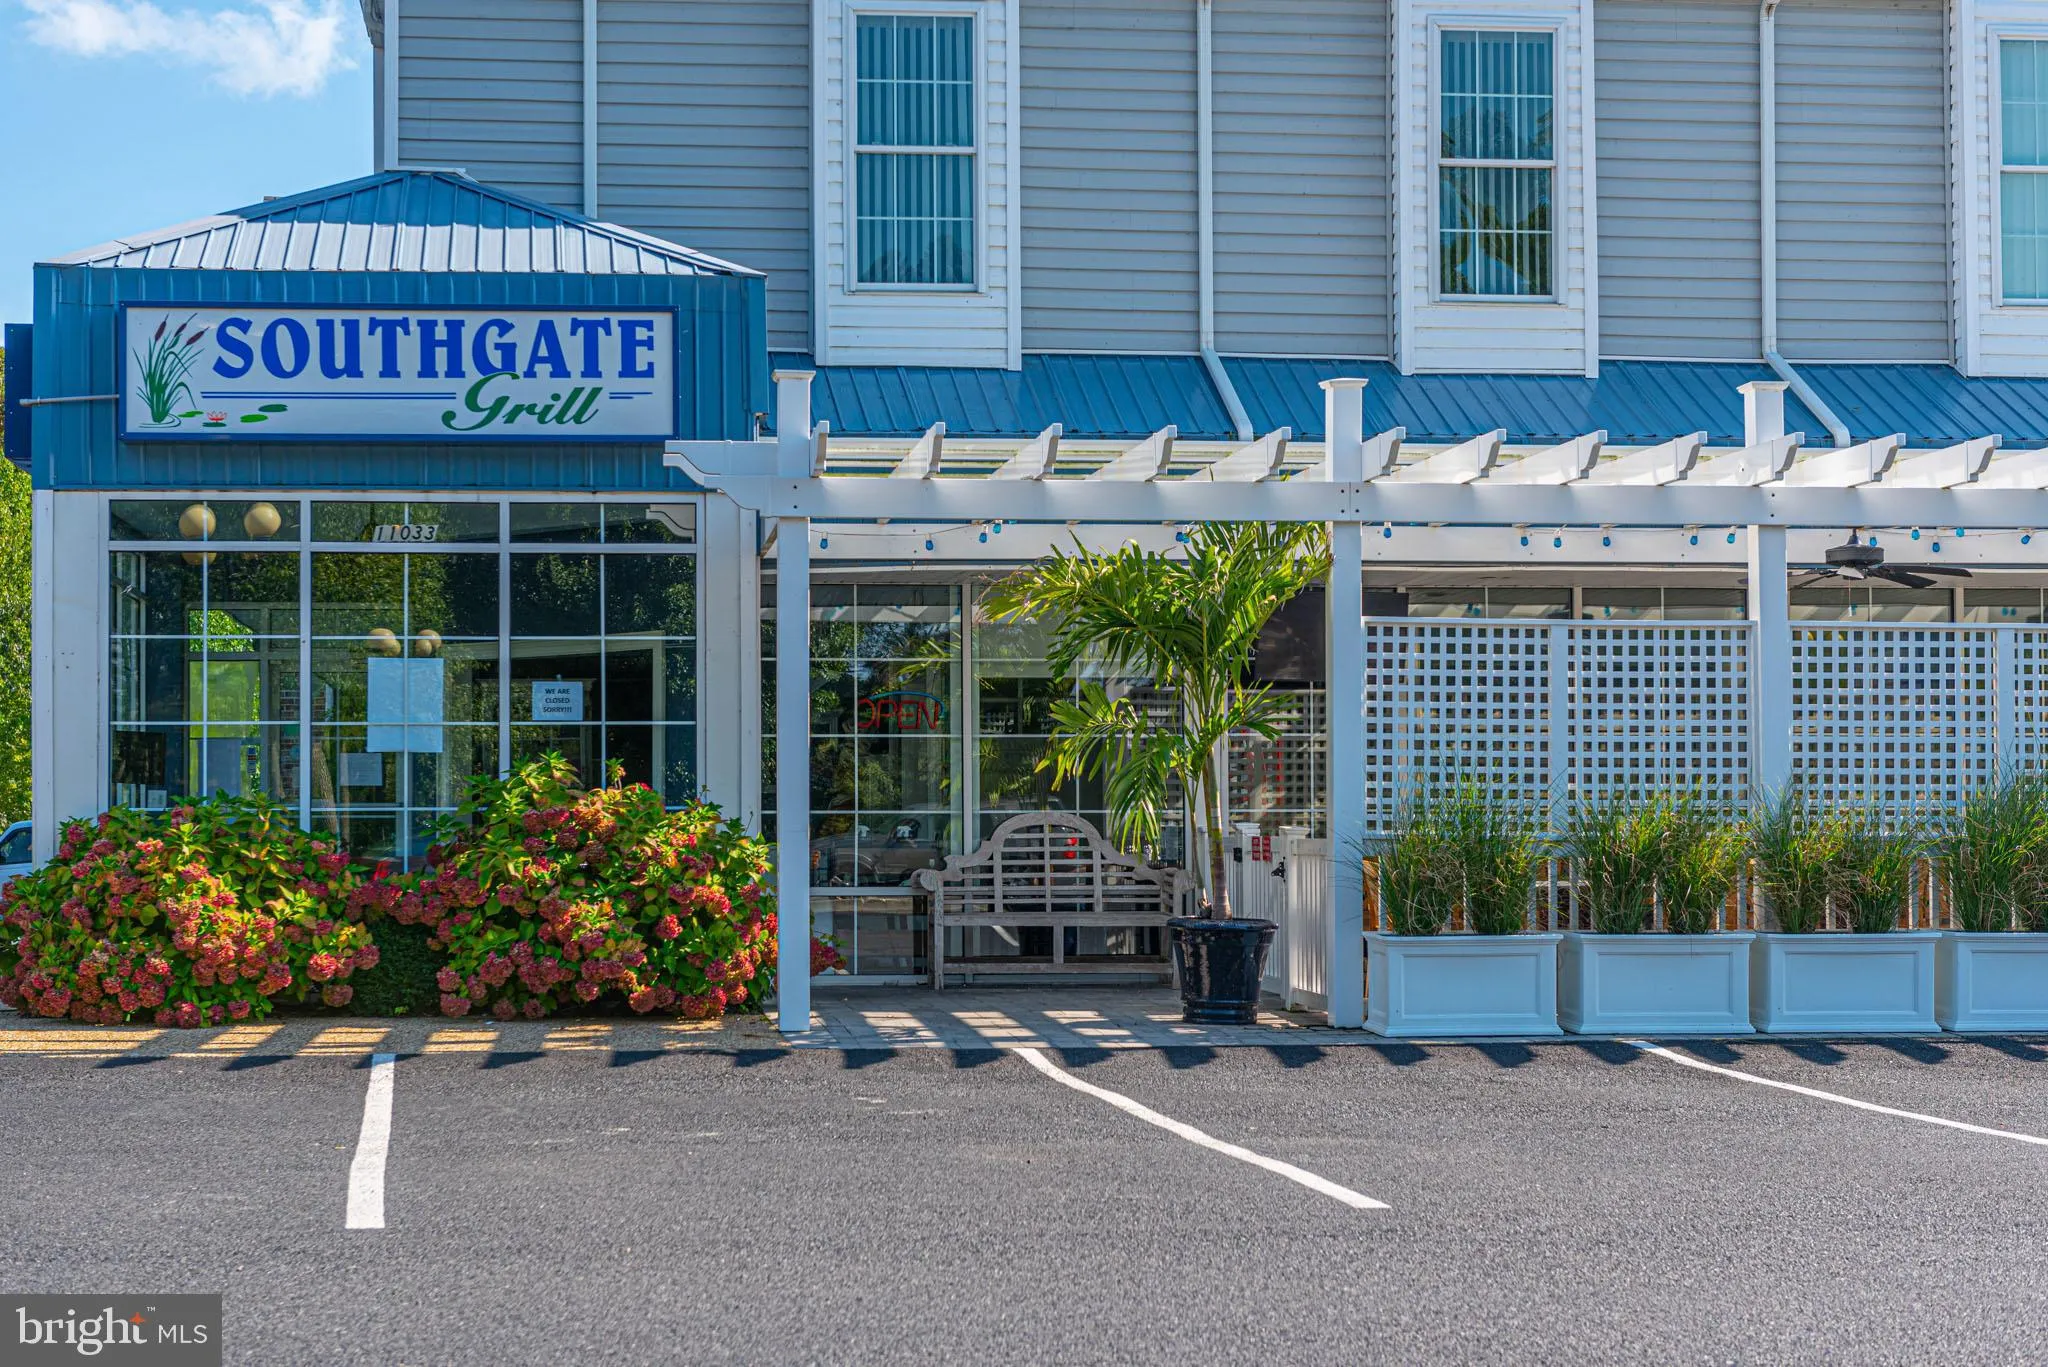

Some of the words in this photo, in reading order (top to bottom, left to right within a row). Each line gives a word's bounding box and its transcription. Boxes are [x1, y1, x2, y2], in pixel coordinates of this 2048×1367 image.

[212, 316, 656, 380] SOUTHGATE
[441, 371, 604, 432] Grill
[377, 525, 436, 541] 11033
[856, 698, 940, 730] OPEN
